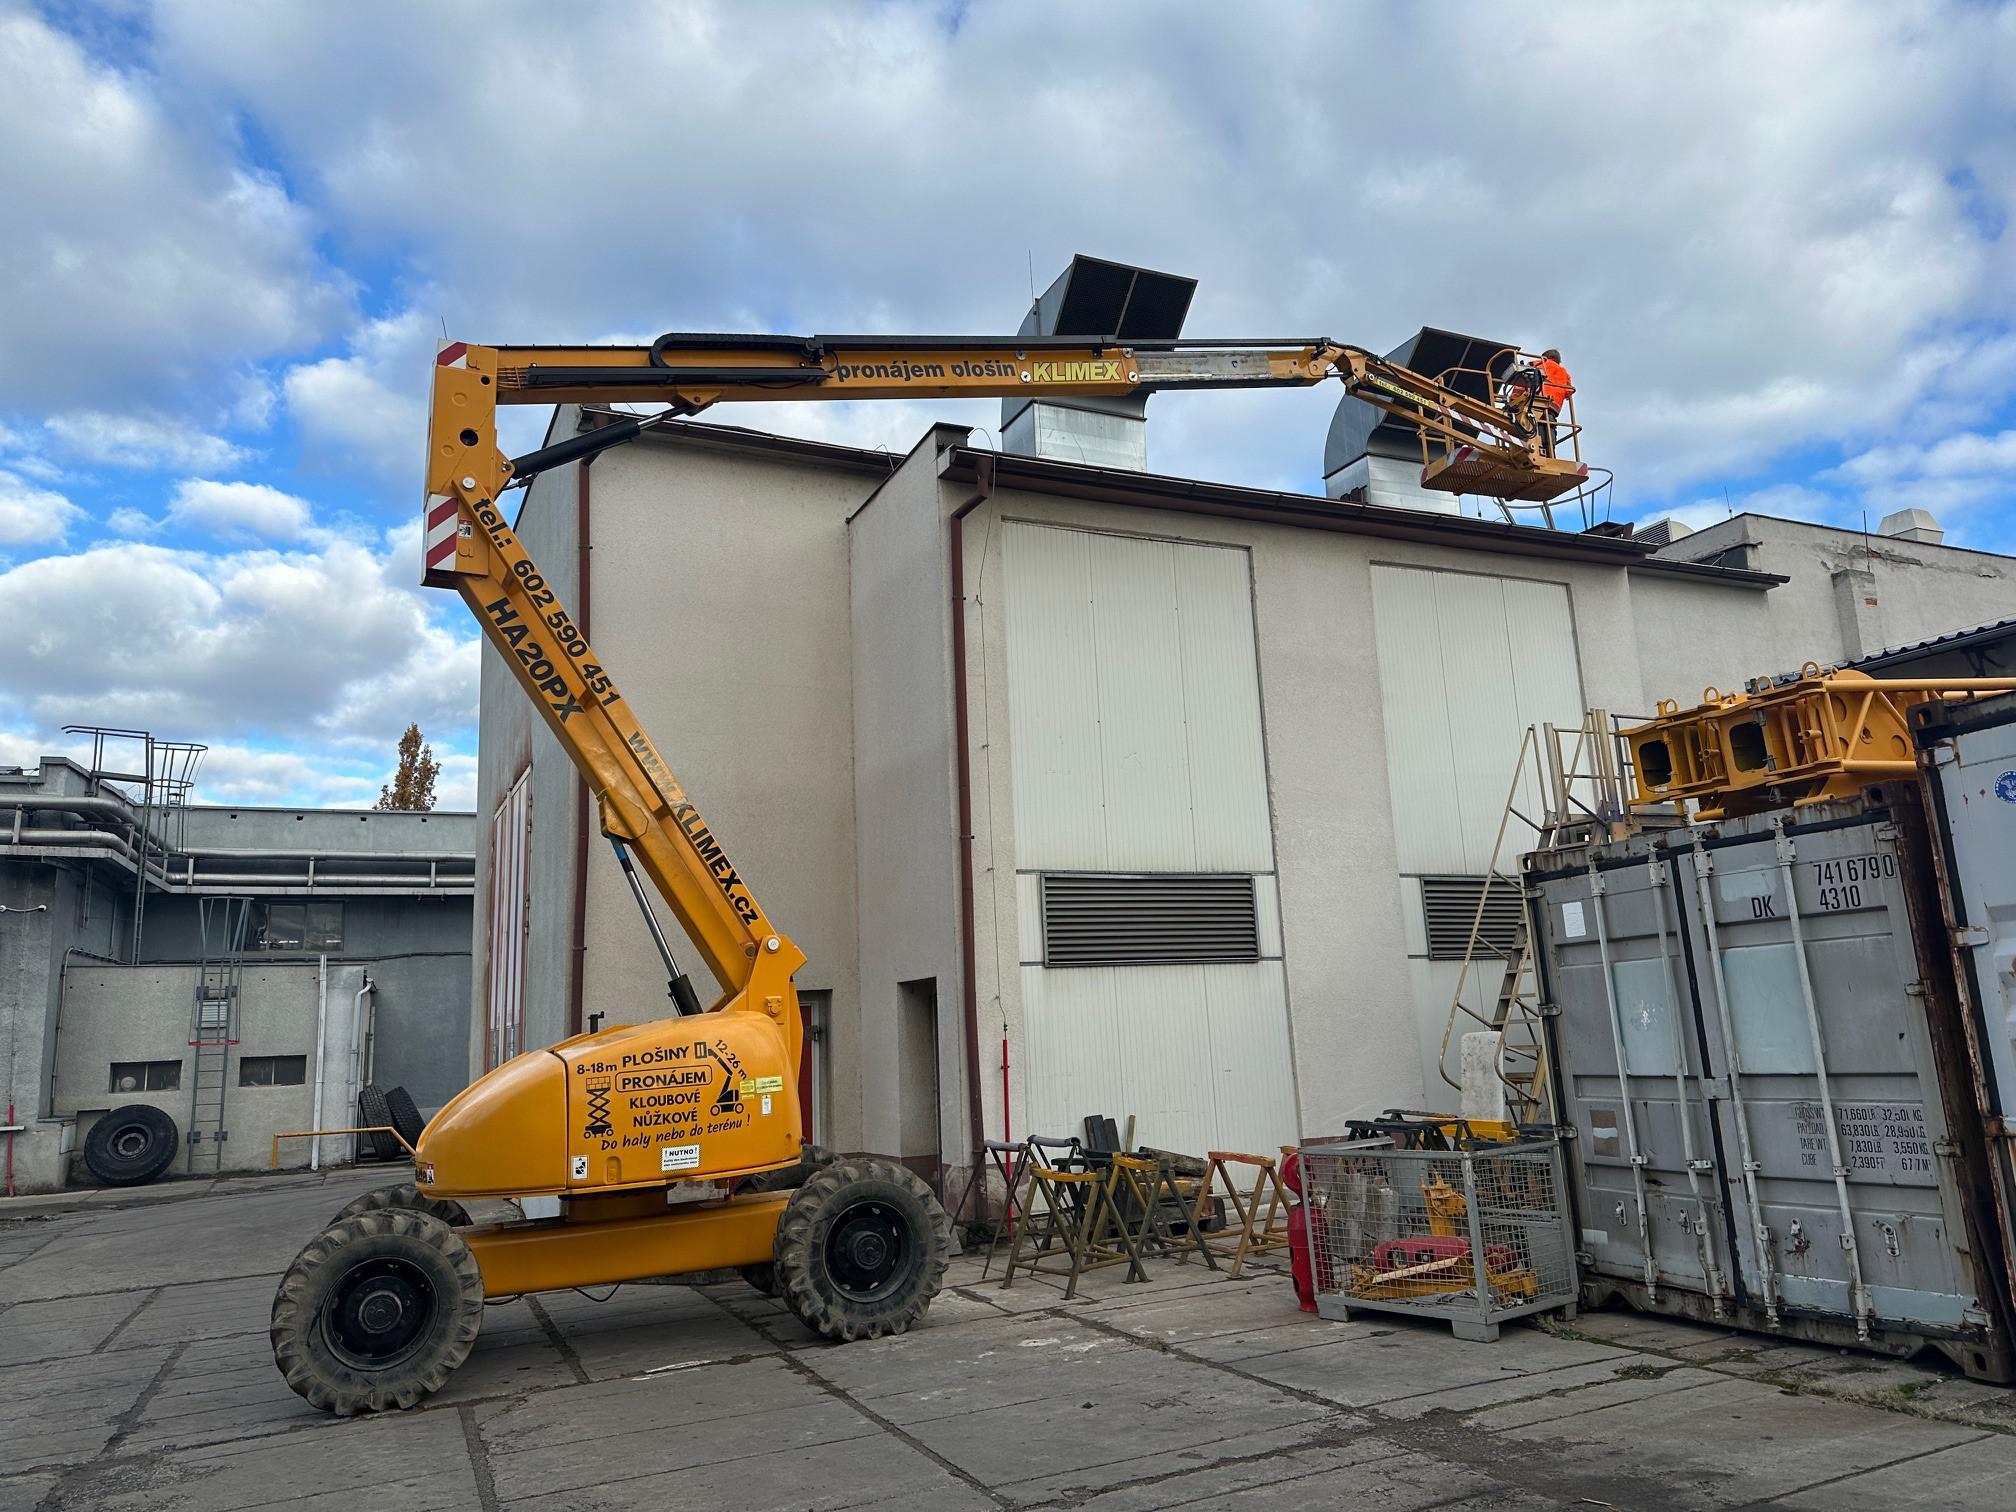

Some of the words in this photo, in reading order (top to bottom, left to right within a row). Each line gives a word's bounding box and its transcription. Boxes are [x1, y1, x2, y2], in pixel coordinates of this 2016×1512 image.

[837, 360, 945, 382] pronájem
[1032, 361, 1121, 382] KLIMEX
[513, 559, 555, 609] 602
[547, 611, 588, 658] 590
[582, 663, 621, 707] 451
[486, 597, 585, 723] HA20PX
[1751, 895, 1775, 918] DK
[1819, 885, 1861, 910] 4310
[622, 1046, 690, 1068] PLOŠINY
[715, 1039, 741, 1069] 12-26
[622, 1070, 707, 1090] PRONÁJEM
[629, 1088, 701, 1109] KLOUBOVÉ
[633, 1107, 698, 1128] NŮŽKOVÉ
[601, 1139, 618, 1151] Do
[623, 1132, 651, 1149] haly
[655, 1127, 685, 1143] nebo
[689, 1123, 704, 1137] do
[707, 1117, 743, 1134] terénu
[669, 1149, 694, 1157] NUTNO
